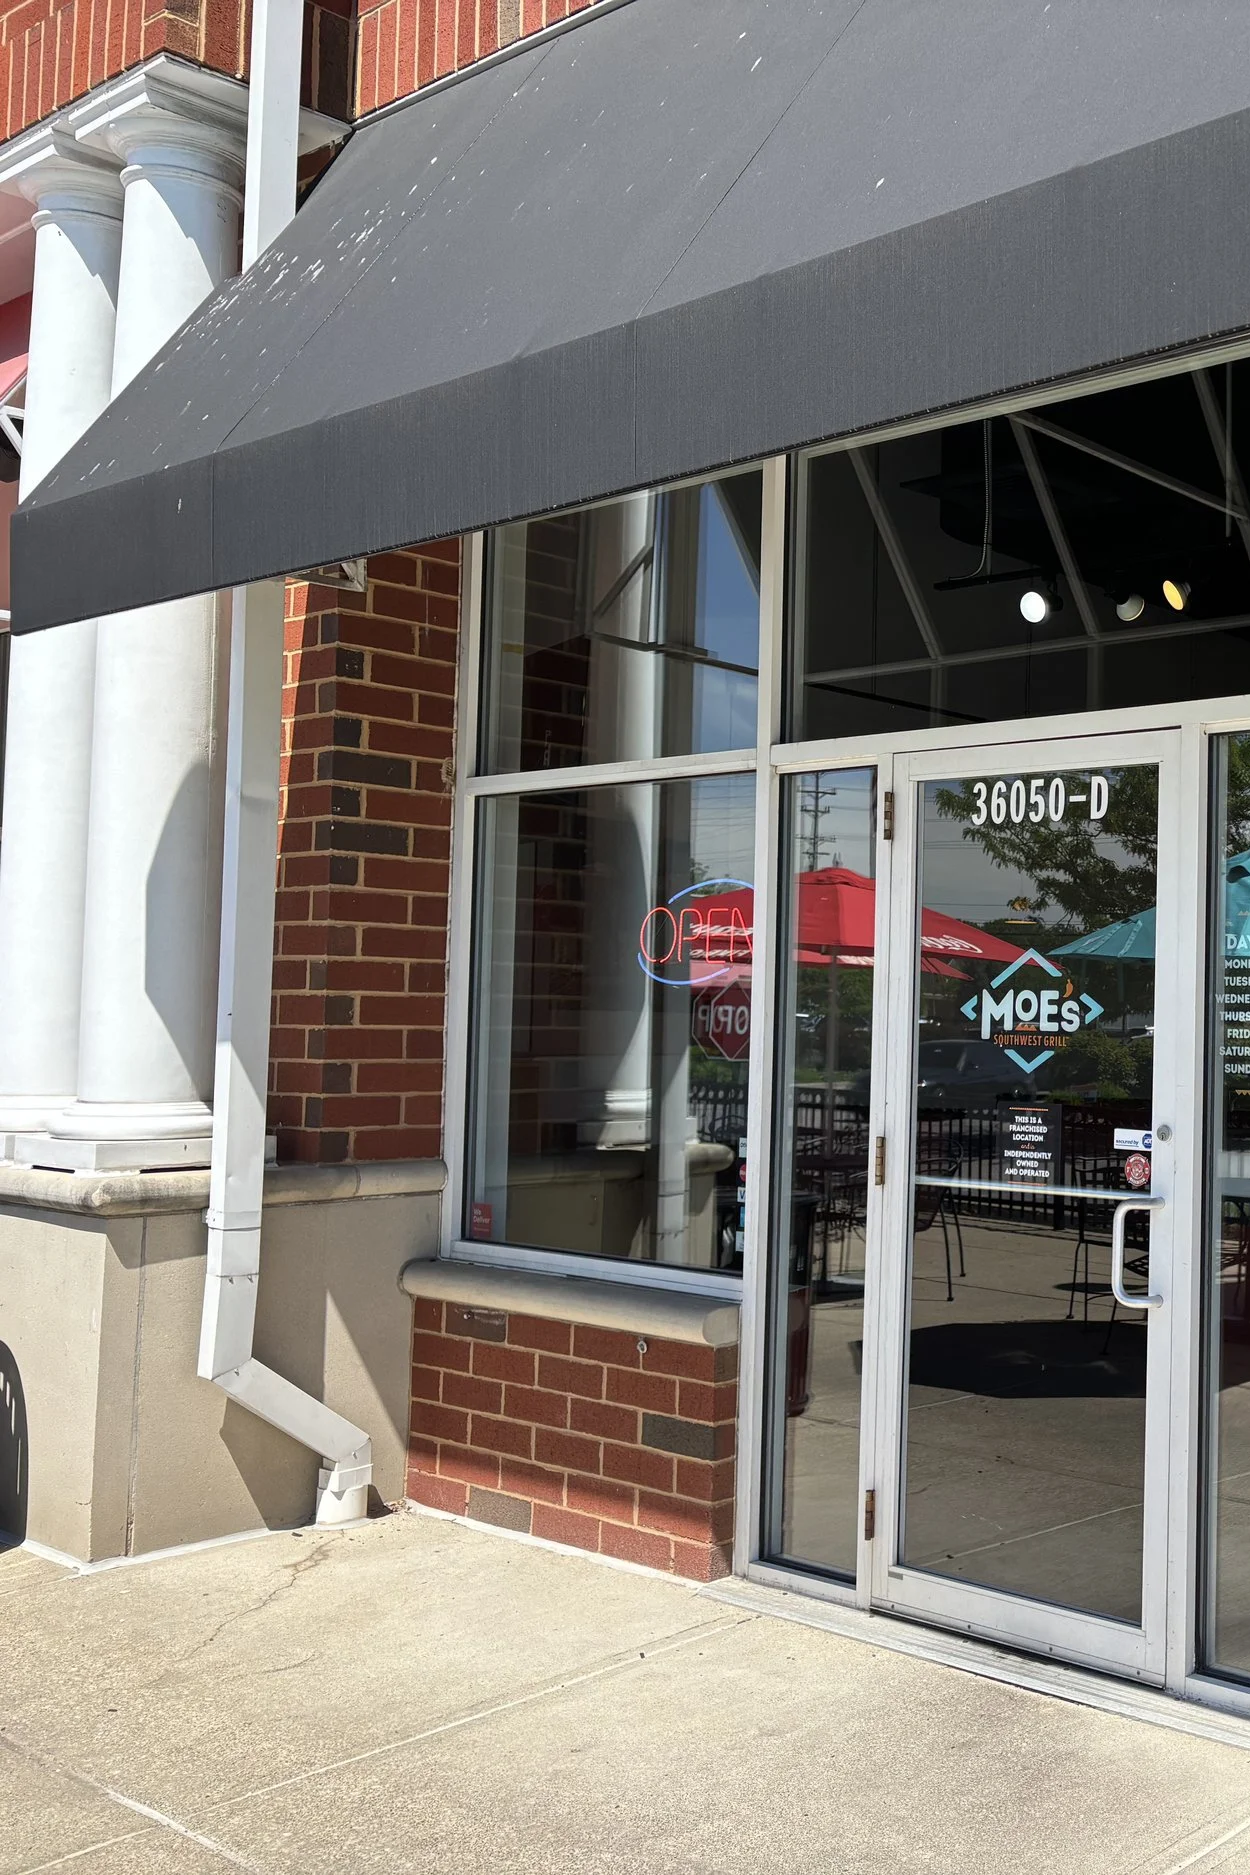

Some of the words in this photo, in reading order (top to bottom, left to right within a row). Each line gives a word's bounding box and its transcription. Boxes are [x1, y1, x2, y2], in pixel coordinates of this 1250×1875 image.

[971, 776, 1109, 826] 36050-D
[639, 906, 753, 964] OPEN
[993, 1034, 1041, 1047] SOUTHWEST
[1044, 1035, 1067, 1047] GRILL
[1009, 1125, 1048, 1133] FRANCHISED
[1013, 1133, 1044, 1142] LOCATION
[1004, 1150, 1052, 1159] INDEPENDENTLY
[1016, 1160, 1039, 1168] OWNED
[1019, 1169, 1050, 1178] OPERATED
